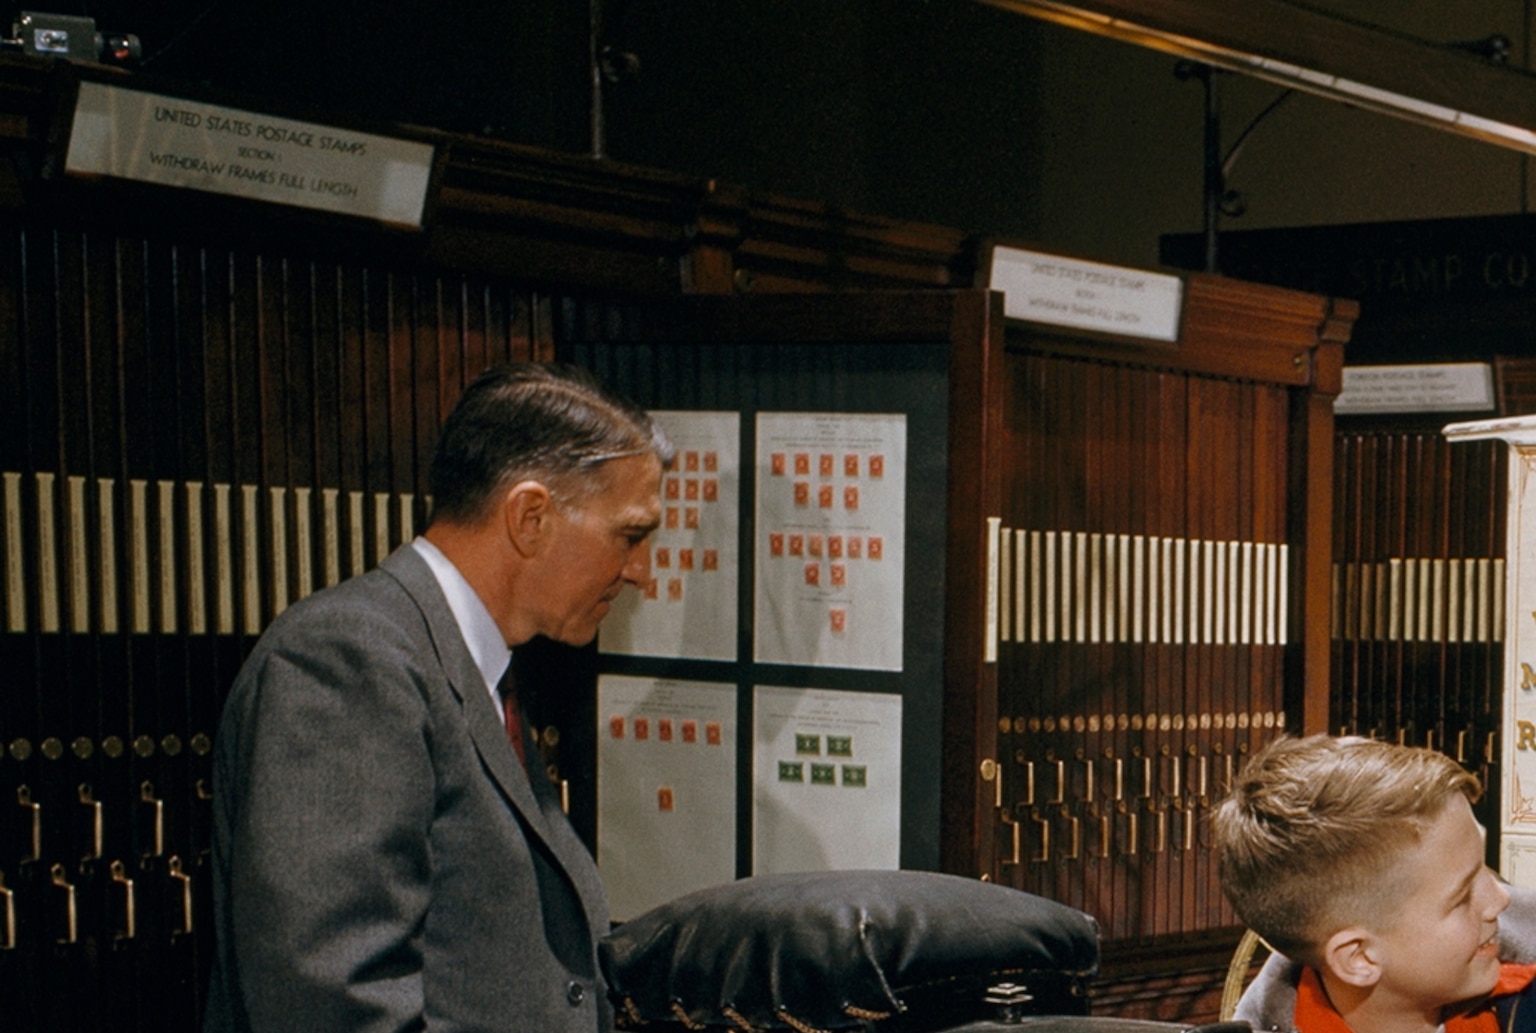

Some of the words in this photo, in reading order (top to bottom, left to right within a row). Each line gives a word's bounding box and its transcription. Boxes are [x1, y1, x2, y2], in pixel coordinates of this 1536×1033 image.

[155, 106, 201, 128] UNITED
[206, 116, 252, 137] STATES
[256, 125, 314, 147] POSTAGE
[318, 136, 367, 156] STAMPS
[237, 146, 276, 162] SECTION
[150, 152, 226, 175] WITHDRAW
[227, 165, 276, 184] FRAMES
[279, 173, 306, 190] FULL
[309, 179, 359, 198] LENGTH
